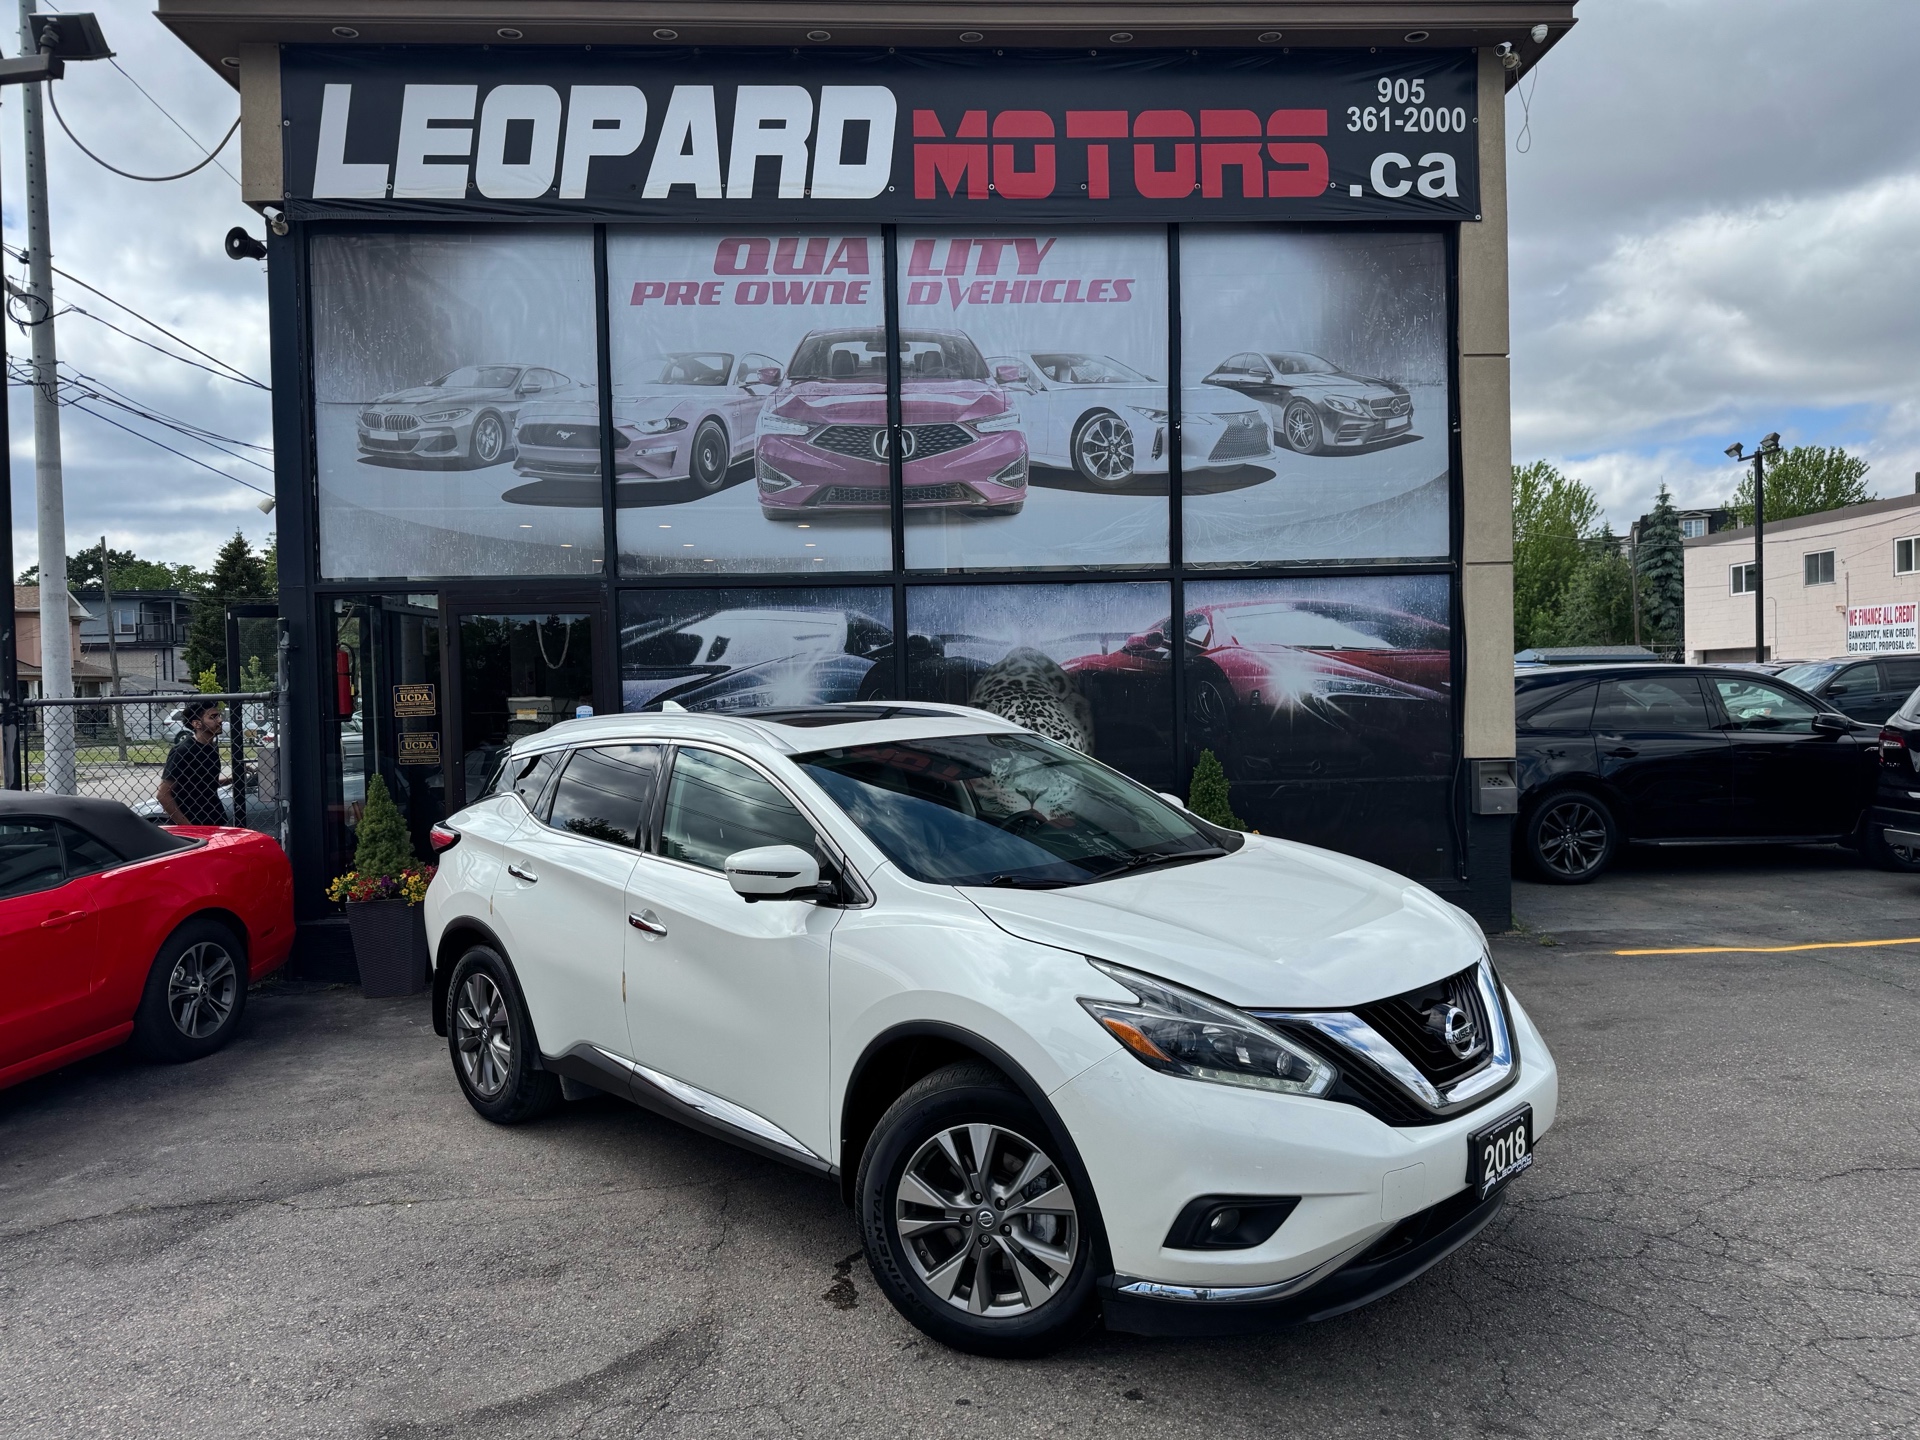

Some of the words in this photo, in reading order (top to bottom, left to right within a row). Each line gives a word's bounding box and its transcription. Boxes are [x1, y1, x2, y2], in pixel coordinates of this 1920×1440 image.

[1377, 77, 1426, 104] 905
[1346, 105, 1467, 133] 361-2000
[313, 84, 897, 199] LEOPARD
[913, 109, 1329, 199] MOTORS
[1349, 151, 1459, 199] .ca
[629, 281, 724, 306] PRE
[1849, 609, 1857, 626] WE
[1858, 607, 1881, 625] FINANCE
[1883, 606, 1893, 625] ALL
[1895, 605, 1916, 624] CREDIT
[1849, 642, 1858, 652] BAD
[1879, 640, 1905, 650] PROPOSAL
[1882, 629, 1894, 638] NEW
[400, 693, 430, 702] UCDA
[405, 741, 434, 750] UCDA
[1484, 1126, 1526, 1181] 2018
[1496, 1152, 1533, 1182] LEOPARD
[873, 1183, 933, 1318] ONTINENTAL
